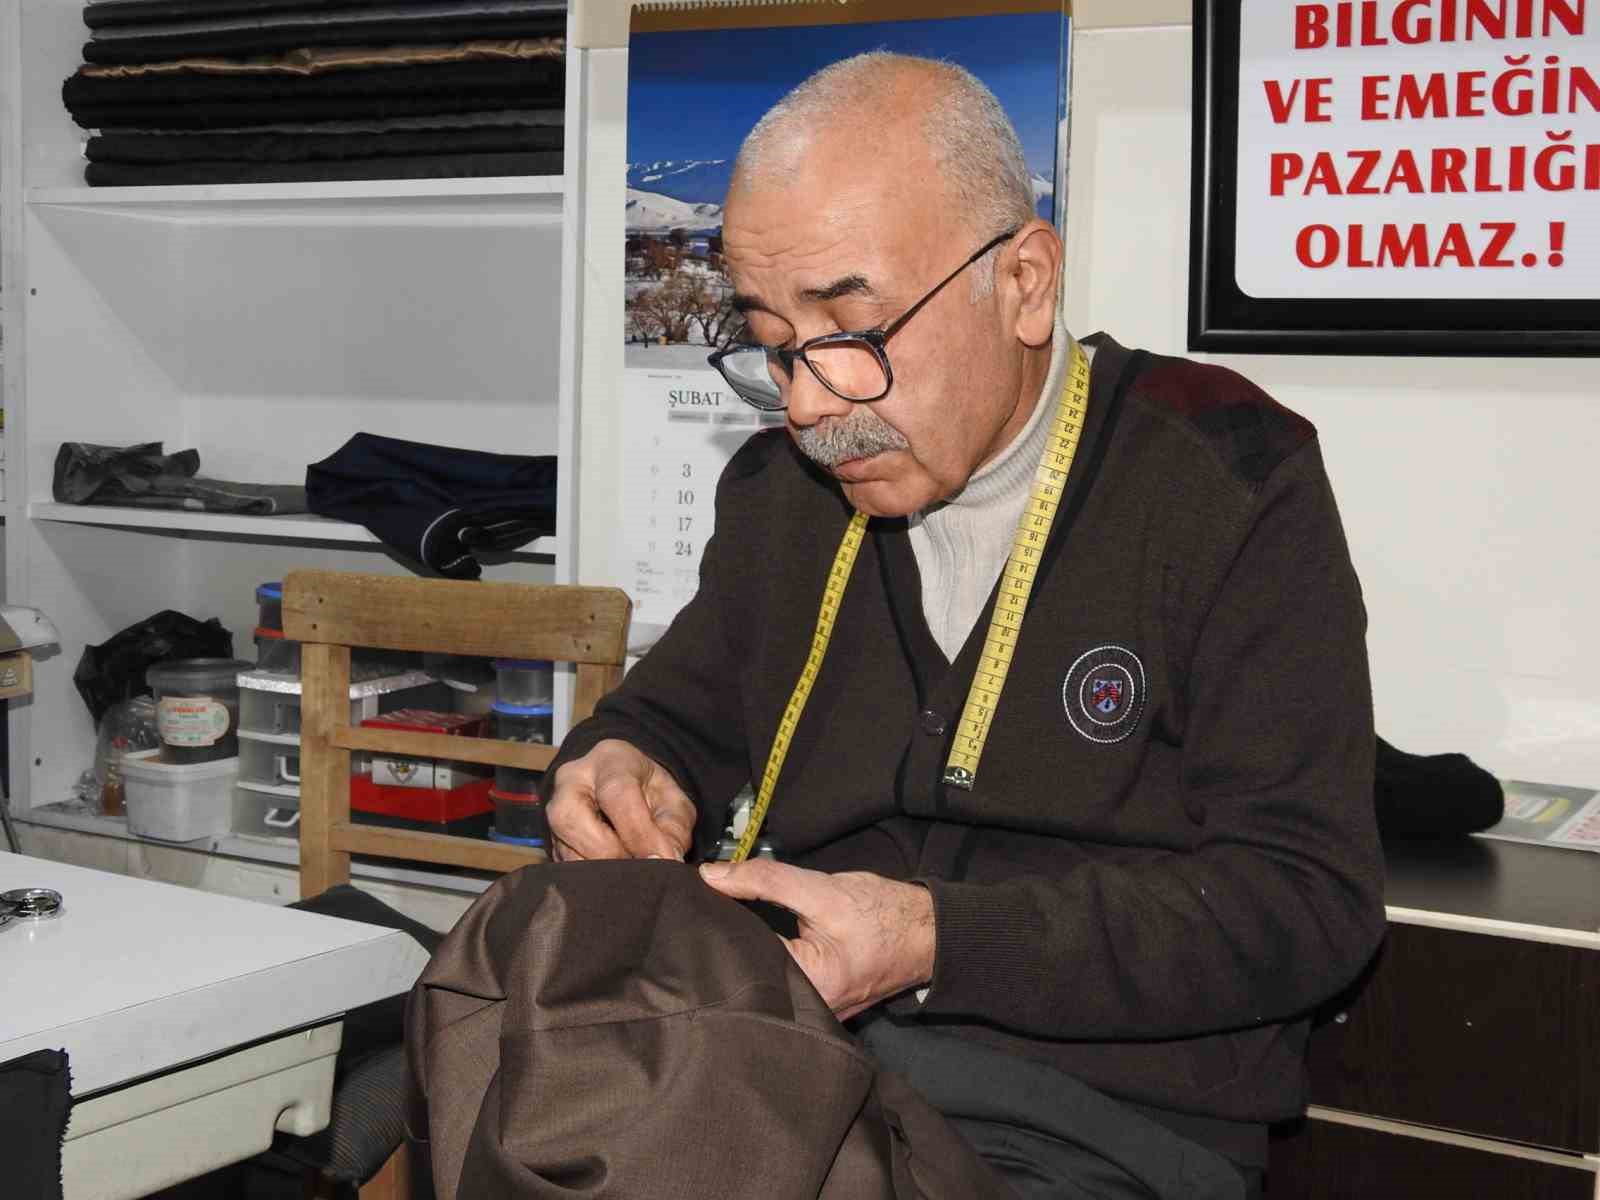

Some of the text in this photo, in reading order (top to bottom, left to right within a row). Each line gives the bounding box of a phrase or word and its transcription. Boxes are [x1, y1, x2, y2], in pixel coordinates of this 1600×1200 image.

[1263, 53, 1600, 124] VE EMEĞİN
[1269, 129, 1600, 197] PAZARLIĞI
[1295, 221, 1565, 269] OLMAZ.!
[667, 389, 722, 408] ŞUBAT
[681, 463, 693, 479] 3
[677, 489, 695, 505] 10
[677, 516, 694, 532] 17
[674, 540, 693, 557] 24
